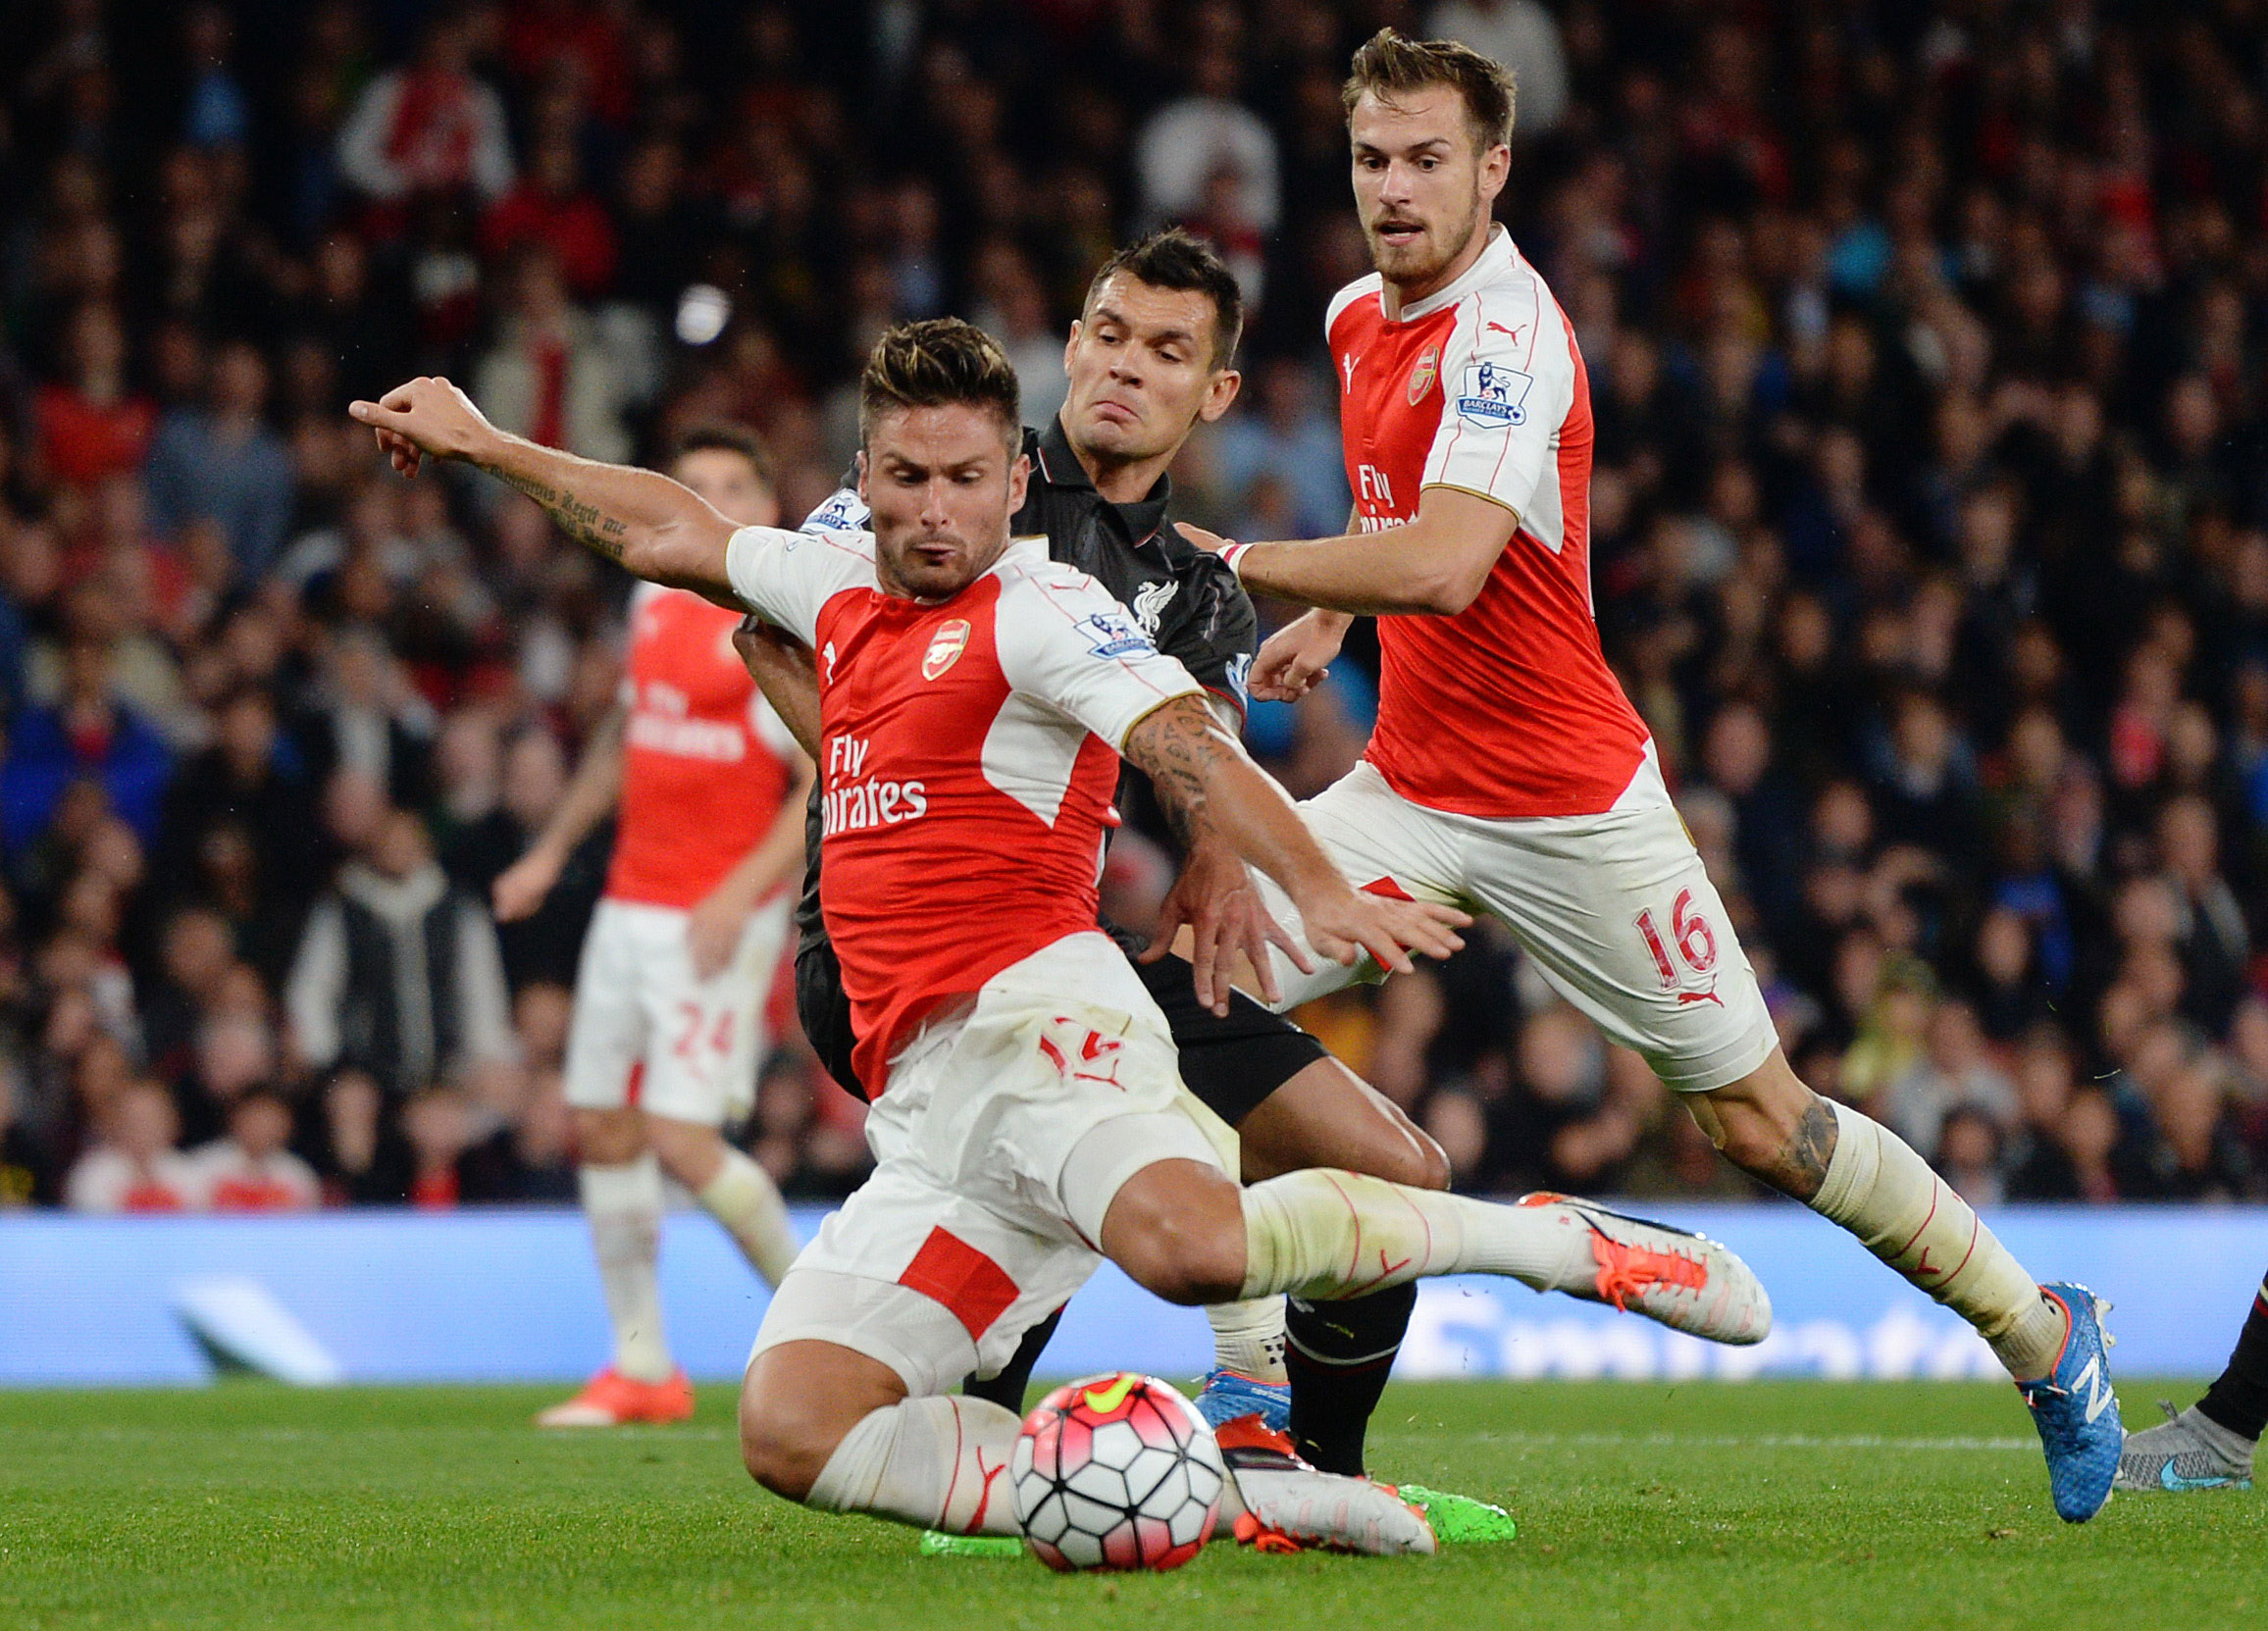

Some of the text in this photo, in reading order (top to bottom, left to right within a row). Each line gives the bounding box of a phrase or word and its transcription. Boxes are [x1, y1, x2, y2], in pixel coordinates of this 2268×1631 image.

[1463, 399, 1508, 414] BARCLAYS
[1358, 464, 1395, 508] Fly
[829, 734, 869, 778] Fly
[821, 775, 928, 838] irates
[1632, 885, 1718, 993] 16
[671, 1000, 737, 1059] 24
